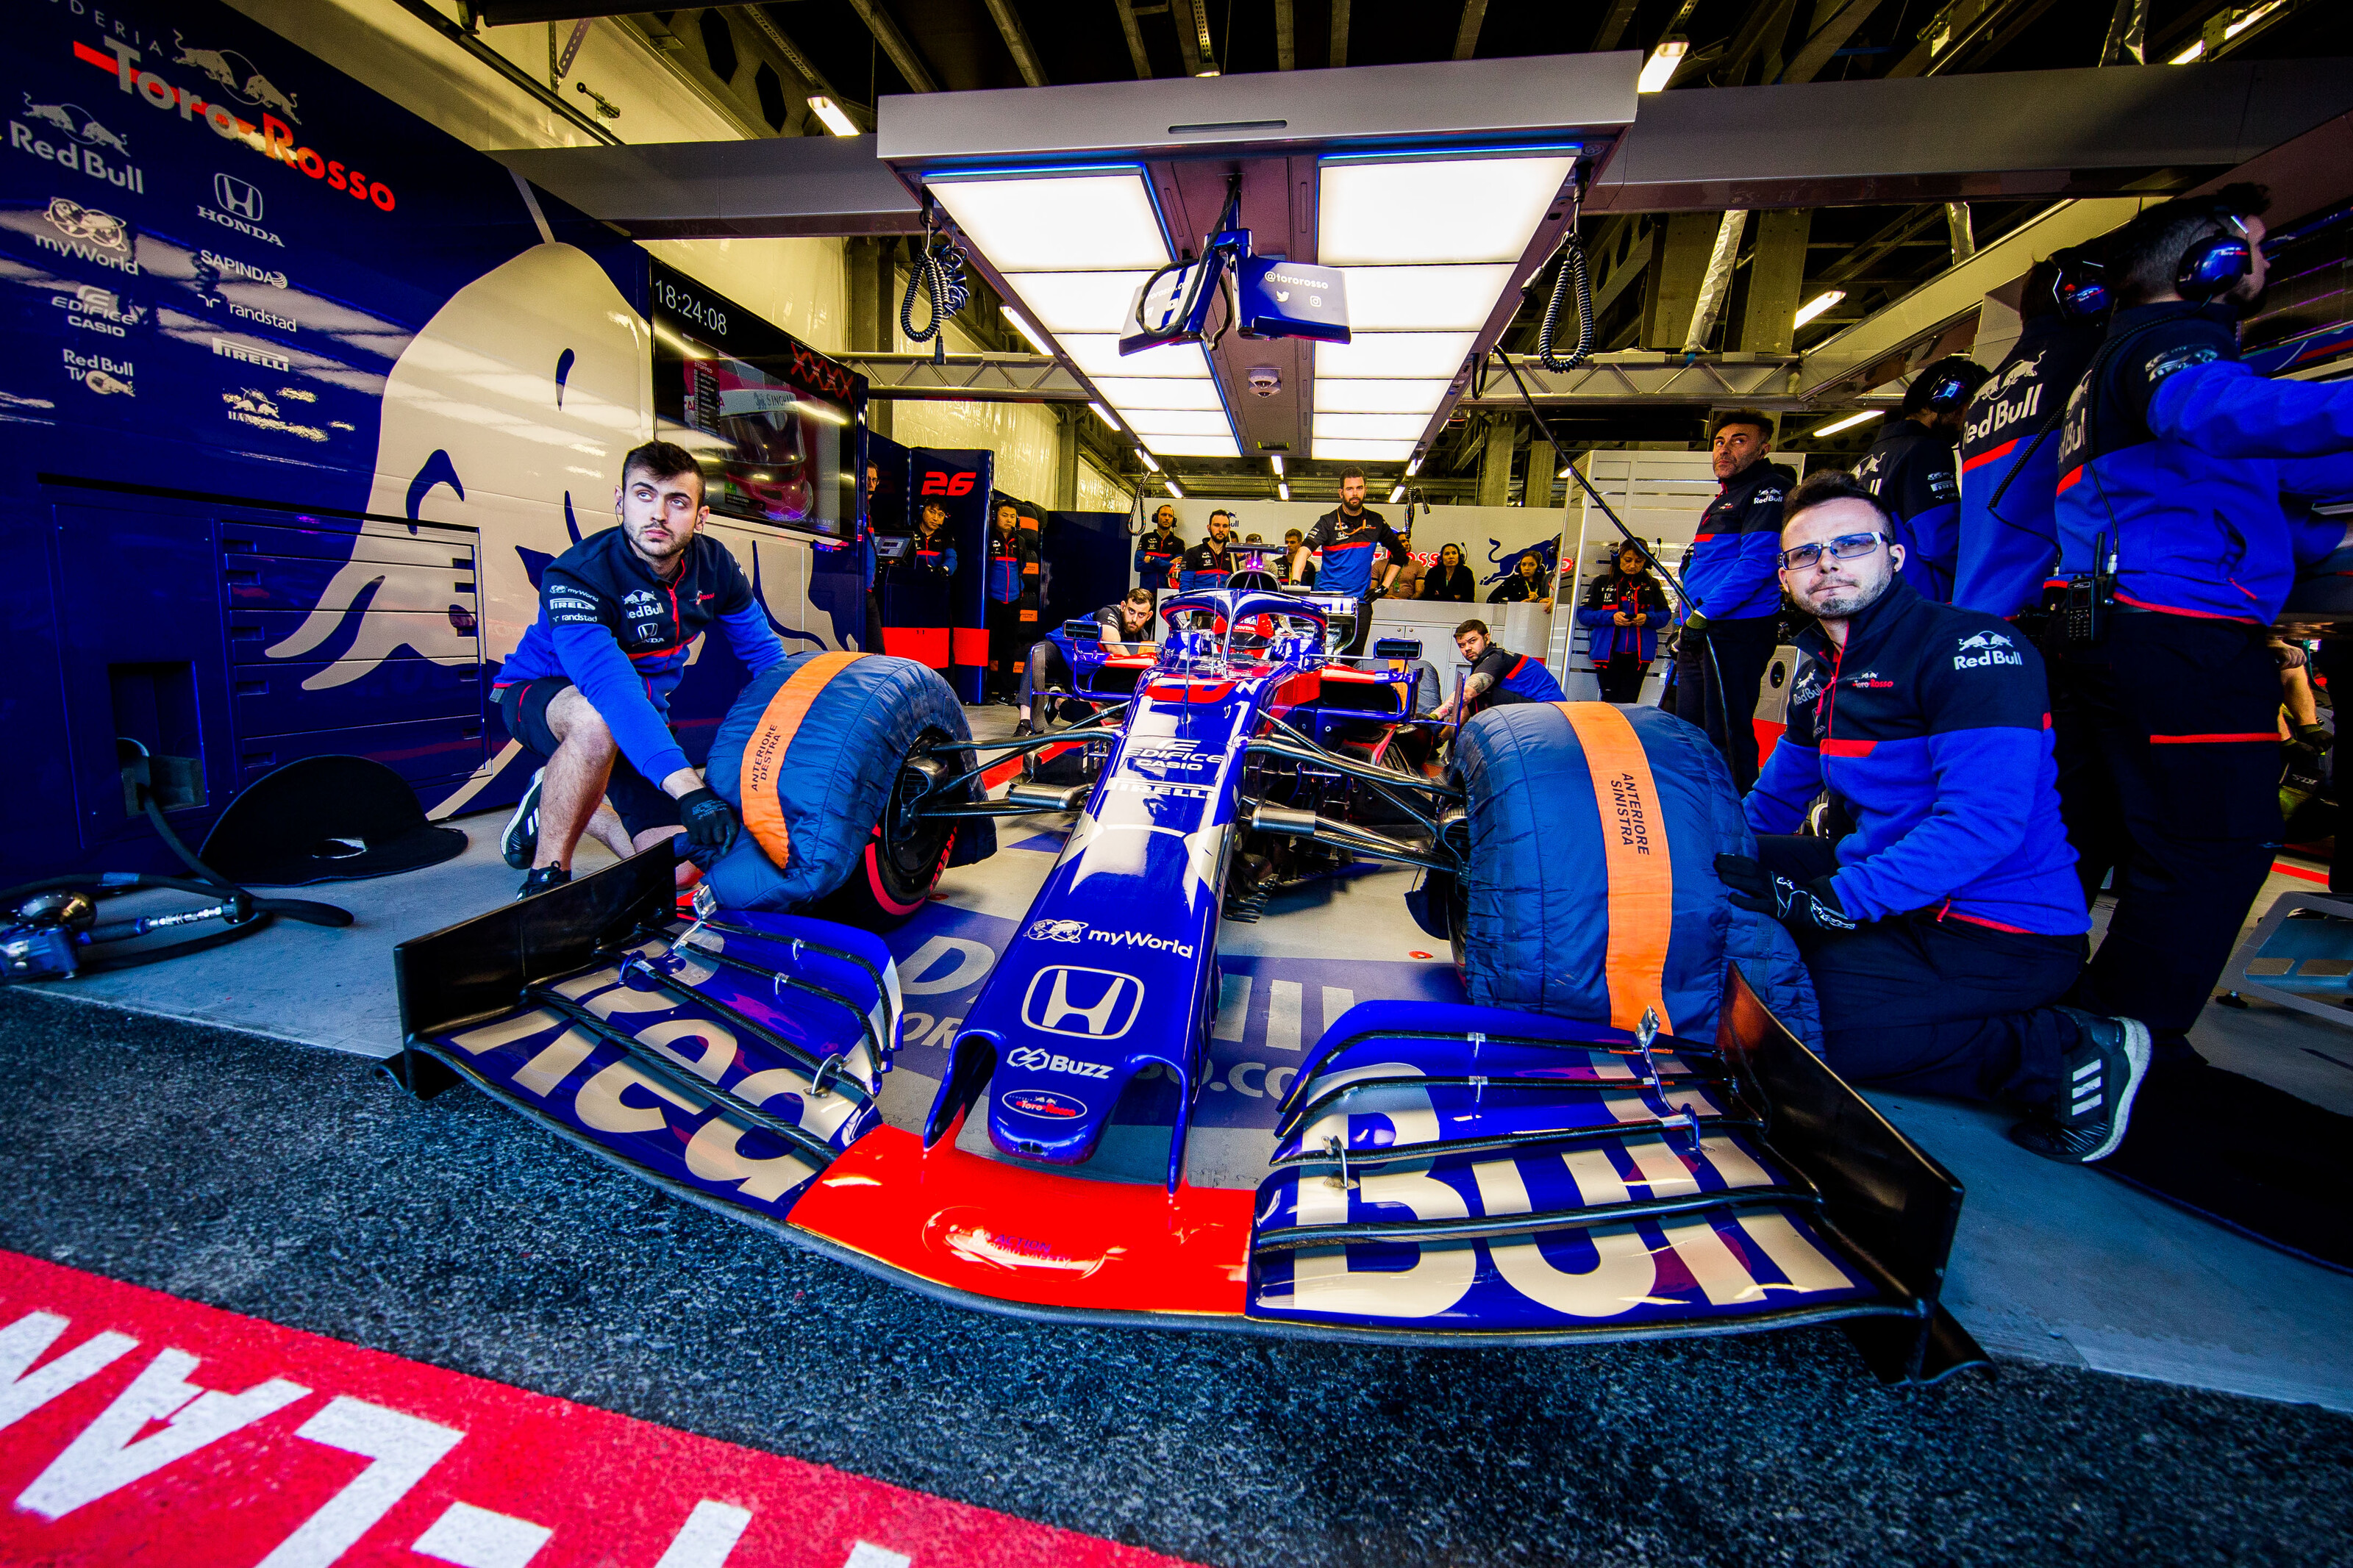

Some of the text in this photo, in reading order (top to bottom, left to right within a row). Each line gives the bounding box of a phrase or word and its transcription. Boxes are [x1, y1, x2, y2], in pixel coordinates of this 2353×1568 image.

[50, 0, 163, 57] DERIA
[104, 35, 395, 212] Toro Rosso
[10, 120, 143, 194] Red Bull
[196, 205, 285, 248] HONDA
[35, 232, 139, 276] myWorld
[201, 249, 276, 284] SAPINDA
[1264, 271, 1329, 290] @tororosso
[51, 296, 138, 325] EDIFICE
[229, 302, 296, 332] randstad
[655, 279, 726, 335] 18:24:08
[67, 315, 125, 337] CASIO
[63, 348, 133, 376] Red Bull
[212, 337, 289, 371] PIRELLI
[65, 365, 85, 382] TV
[1994, 383, 2043, 430] Bull
[2065, 407, 2085, 457] Bul
[921, 471, 976, 496] 26
[1754, 495, 1783, 505] Red Bull
[1229, 520, 1239, 528] ull
[568, 588, 599, 602] myWorld
[643, 602, 664, 616] Bull
[562, 613, 598, 623] randstad
[1954, 650, 2022, 670] Red Bull
[1793, 690, 1809, 706] Red
[1870, 679, 1893, 688] Rosso
[751, 724, 777, 792] ANTERIORE
[760, 735, 781, 781] DESTRA
[1136, 759, 1203, 770] CASIO
[1104, 777, 1218, 800] PIRELLI
[1610, 780, 1633, 845] SINISTRA
[1622, 773, 1649, 856] ANTERIORE
[1088, 928, 1193, 959] myWorld
[1293, 1049, 1854, 1317] Bull
[995, 1234, 1051, 1252] ACTION
